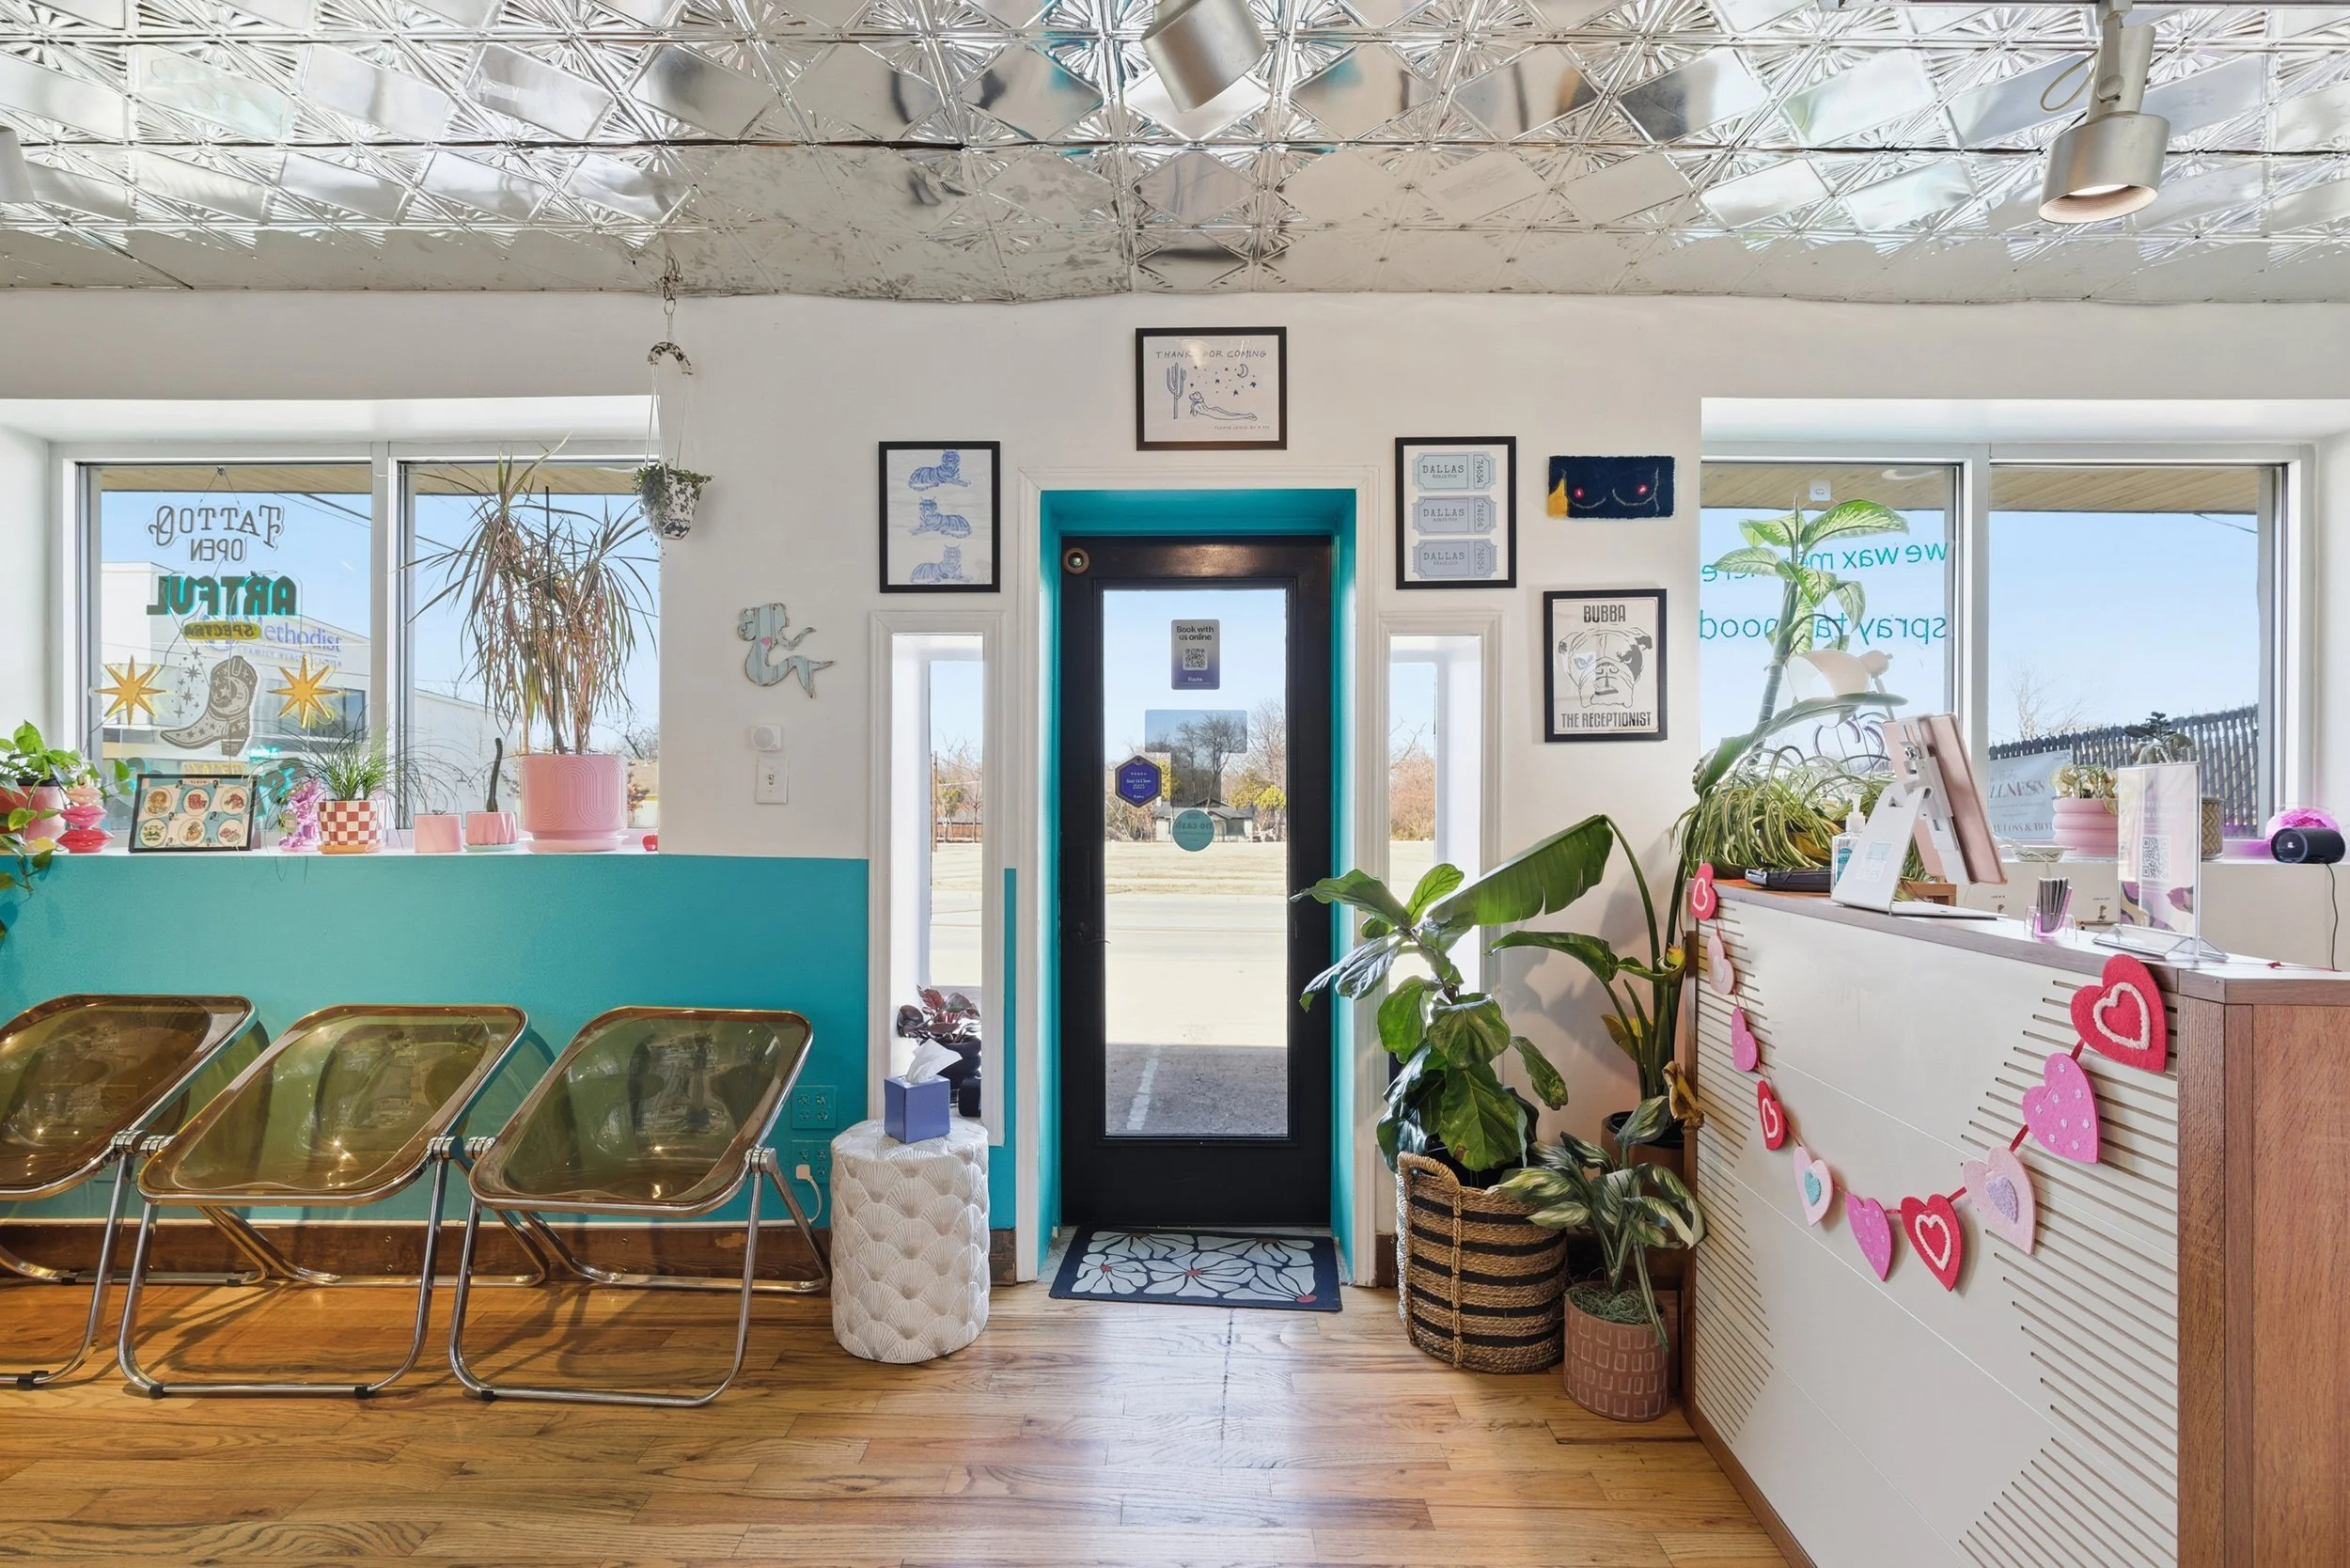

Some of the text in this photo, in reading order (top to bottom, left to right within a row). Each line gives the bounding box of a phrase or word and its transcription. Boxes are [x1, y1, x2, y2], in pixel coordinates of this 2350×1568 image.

[1156, 351, 1198, 359] THANK
[1227, 350, 1267, 358] COMING
[1422, 464, 1465, 474] DALLAS
[1423, 509, 1465, 517] DALLAS
[1423, 552, 1465, 560] DALLAS
[1583, 604, 1626, 623] BUBBA
[1561, 712, 1652, 729] THE RECEPTIONIST
